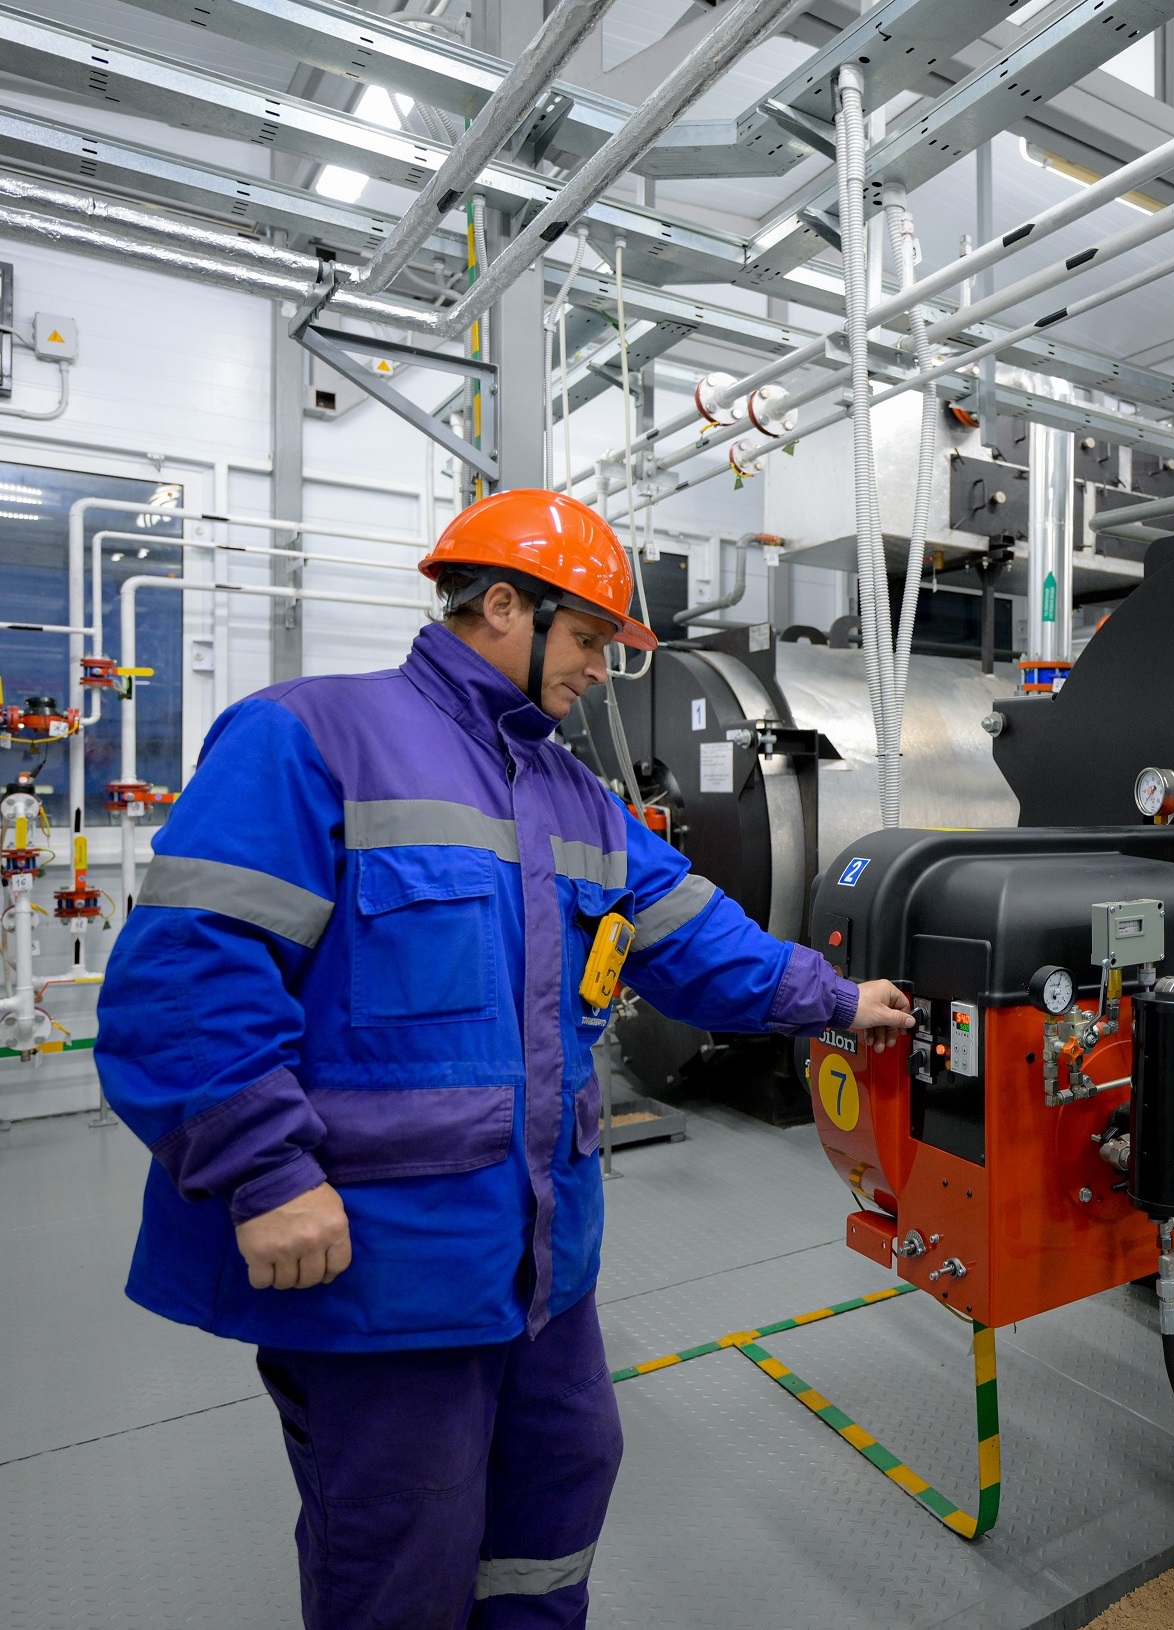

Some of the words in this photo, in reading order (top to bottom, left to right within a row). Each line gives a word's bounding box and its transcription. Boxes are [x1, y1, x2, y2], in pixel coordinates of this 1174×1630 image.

[696, 705, 701, 724] 1
[843, 861, 863, 883] 2
[830, 1069, 847, 1116] 7
